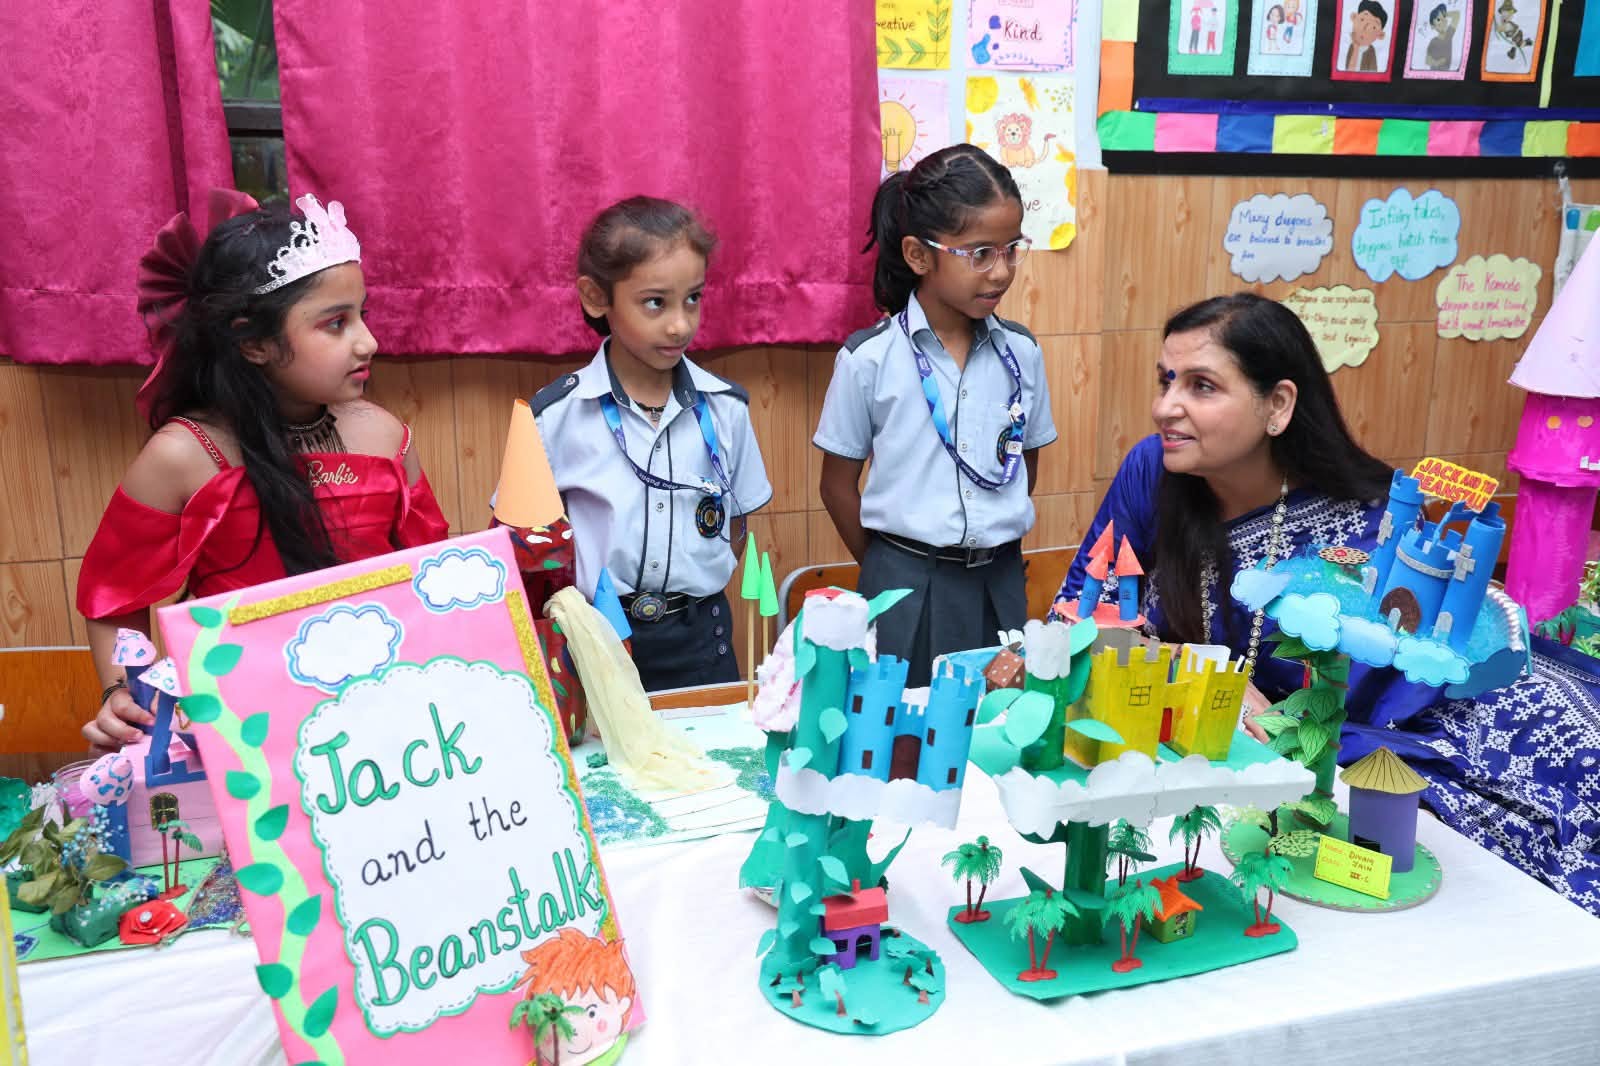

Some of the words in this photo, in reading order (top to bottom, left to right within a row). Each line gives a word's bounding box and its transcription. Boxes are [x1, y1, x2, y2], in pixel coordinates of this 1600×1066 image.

[876, 17, 916, 31] reative
[1239, 209, 1270, 234] Many
[1456, 273, 1475, 292] The
[307, 460, 359, 488] Barbie
[1419, 459, 1462, 482] JACK
[310, 702, 483, 815] Jack
[361, 819, 446, 886] and
[468, 796, 528, 842] the
[353, 848, 605, 1007] Beanstalk
